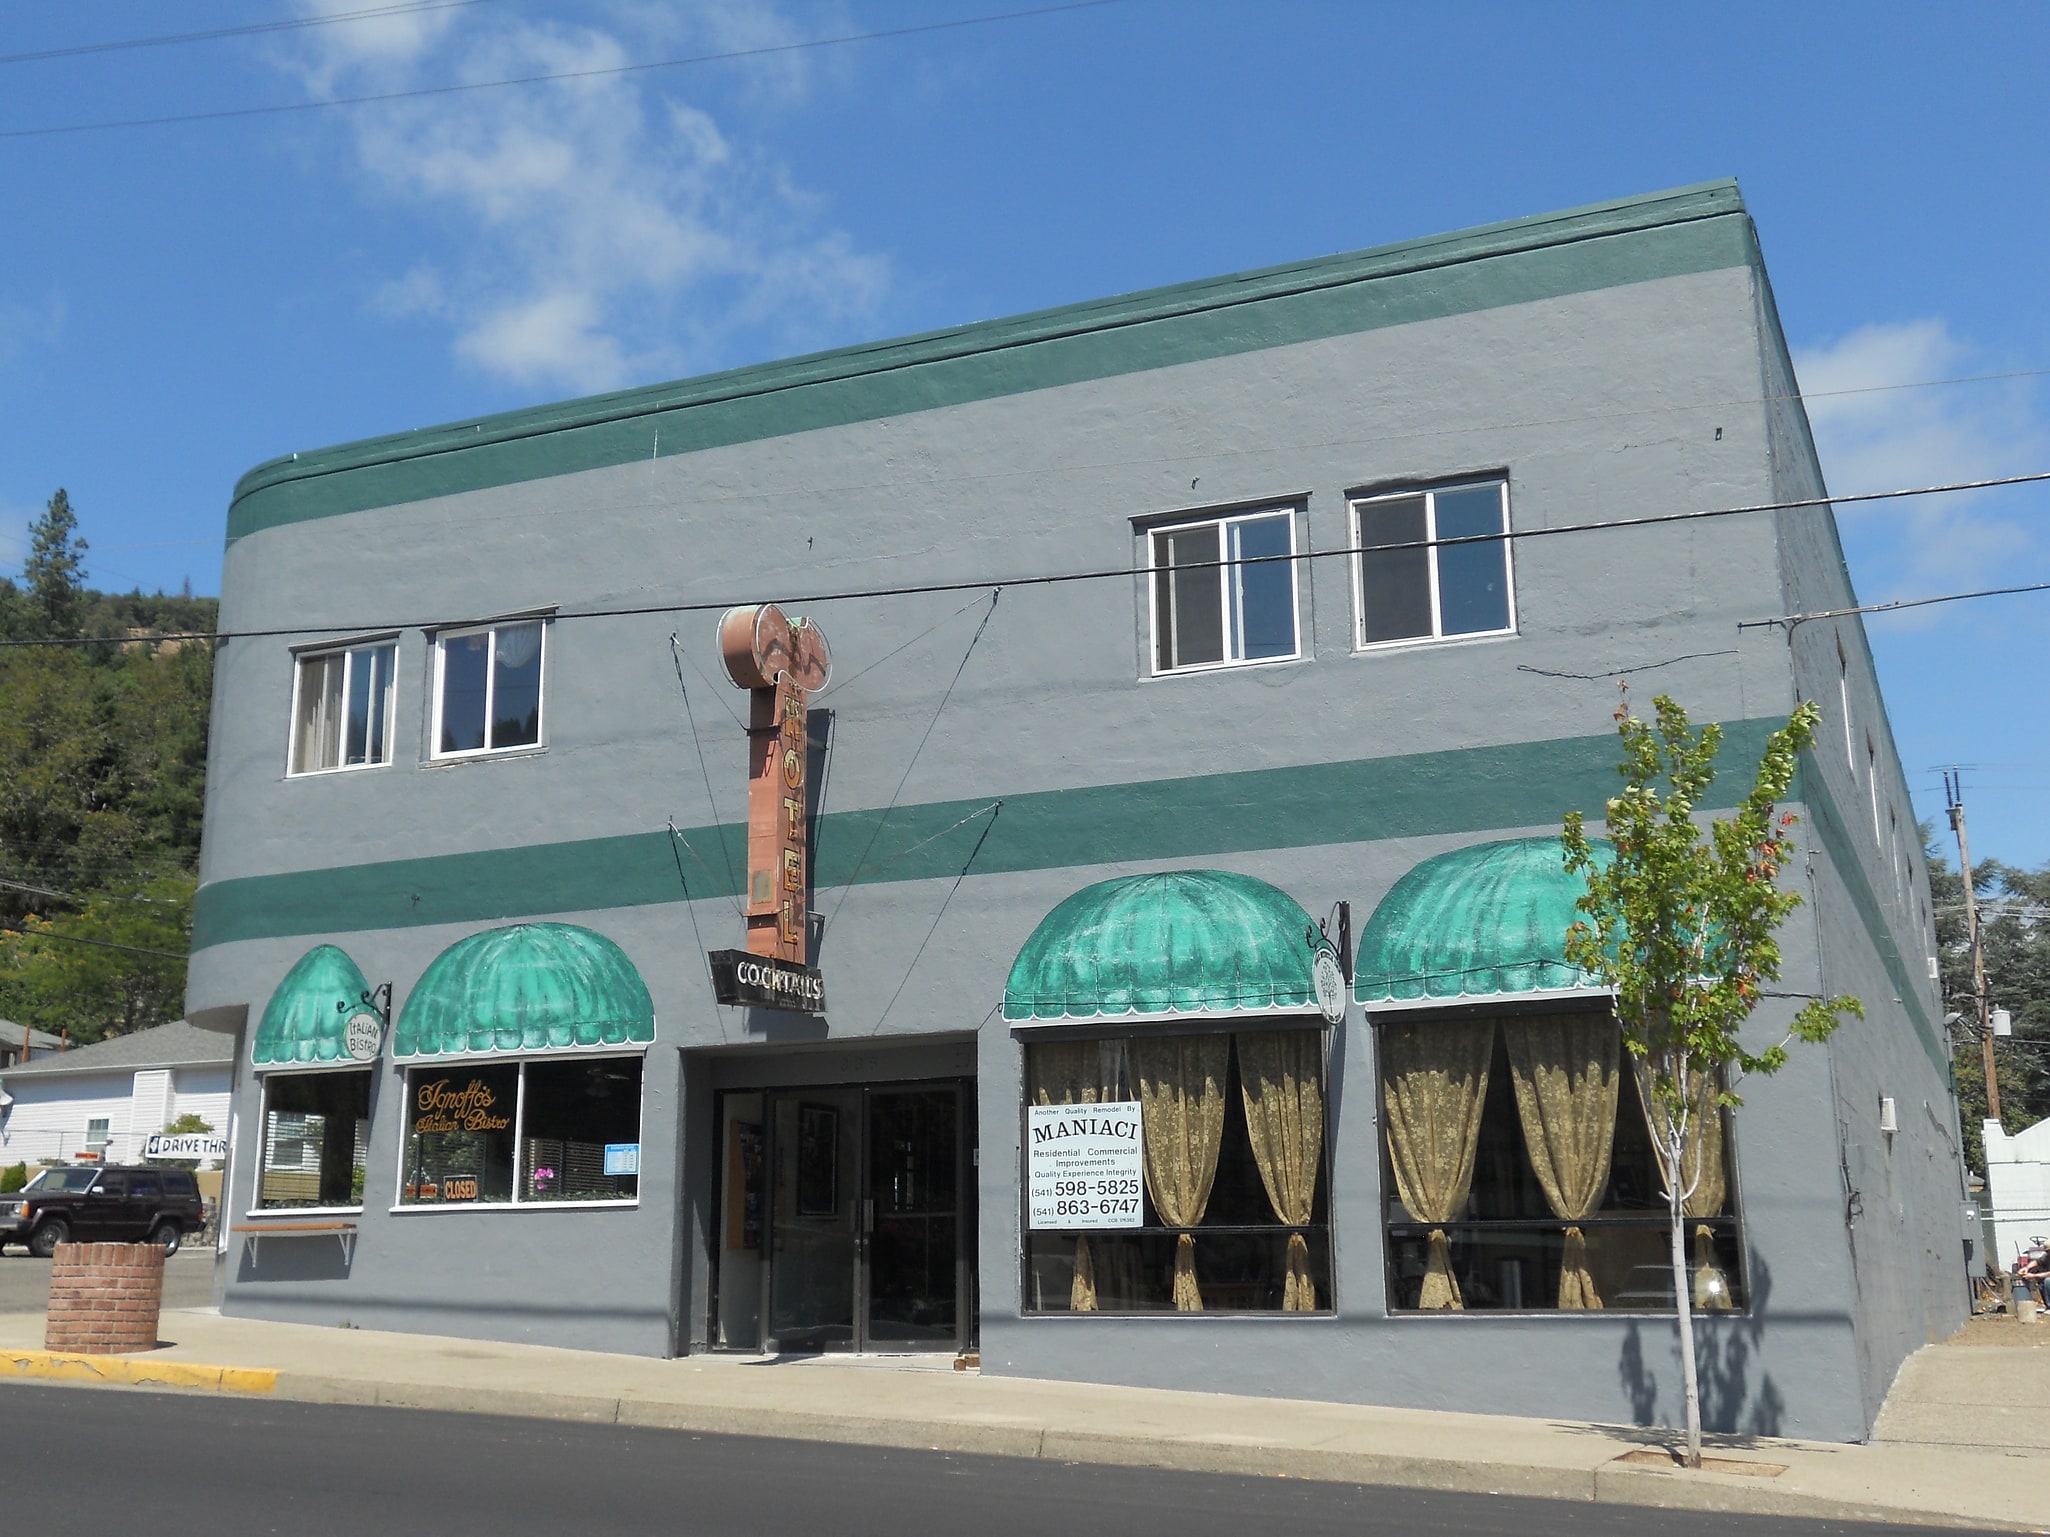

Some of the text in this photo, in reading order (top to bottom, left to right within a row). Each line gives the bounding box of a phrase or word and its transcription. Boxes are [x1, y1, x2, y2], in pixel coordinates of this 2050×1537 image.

[783, 694, 802, 945] HOTEL
[737, 961, 824, 1000] COCKTAILS
[1093, 1106, 1121, 1114] Remodel
[1127, 1105, 1136, 1113] By
[415, 1108, 510, 1134] Italian Bistro
[1032, 1118, 1139, 1144] MANIACI
[163, 1139, 199, 1152] DRIVE
[1033, 1147, 1138, 1158] Residential Commercial
[1055, 1158, 1116, 1168] Improvements
[1034, 1168, 1137, 1179] Quality Experience Integrity
[445, 1181, 476, 1199] CLOSED
[1031, 1180, 1139, 1198] (541) 598-5825
[1033, 1199, 1139, 1217] (541) 863-6747
